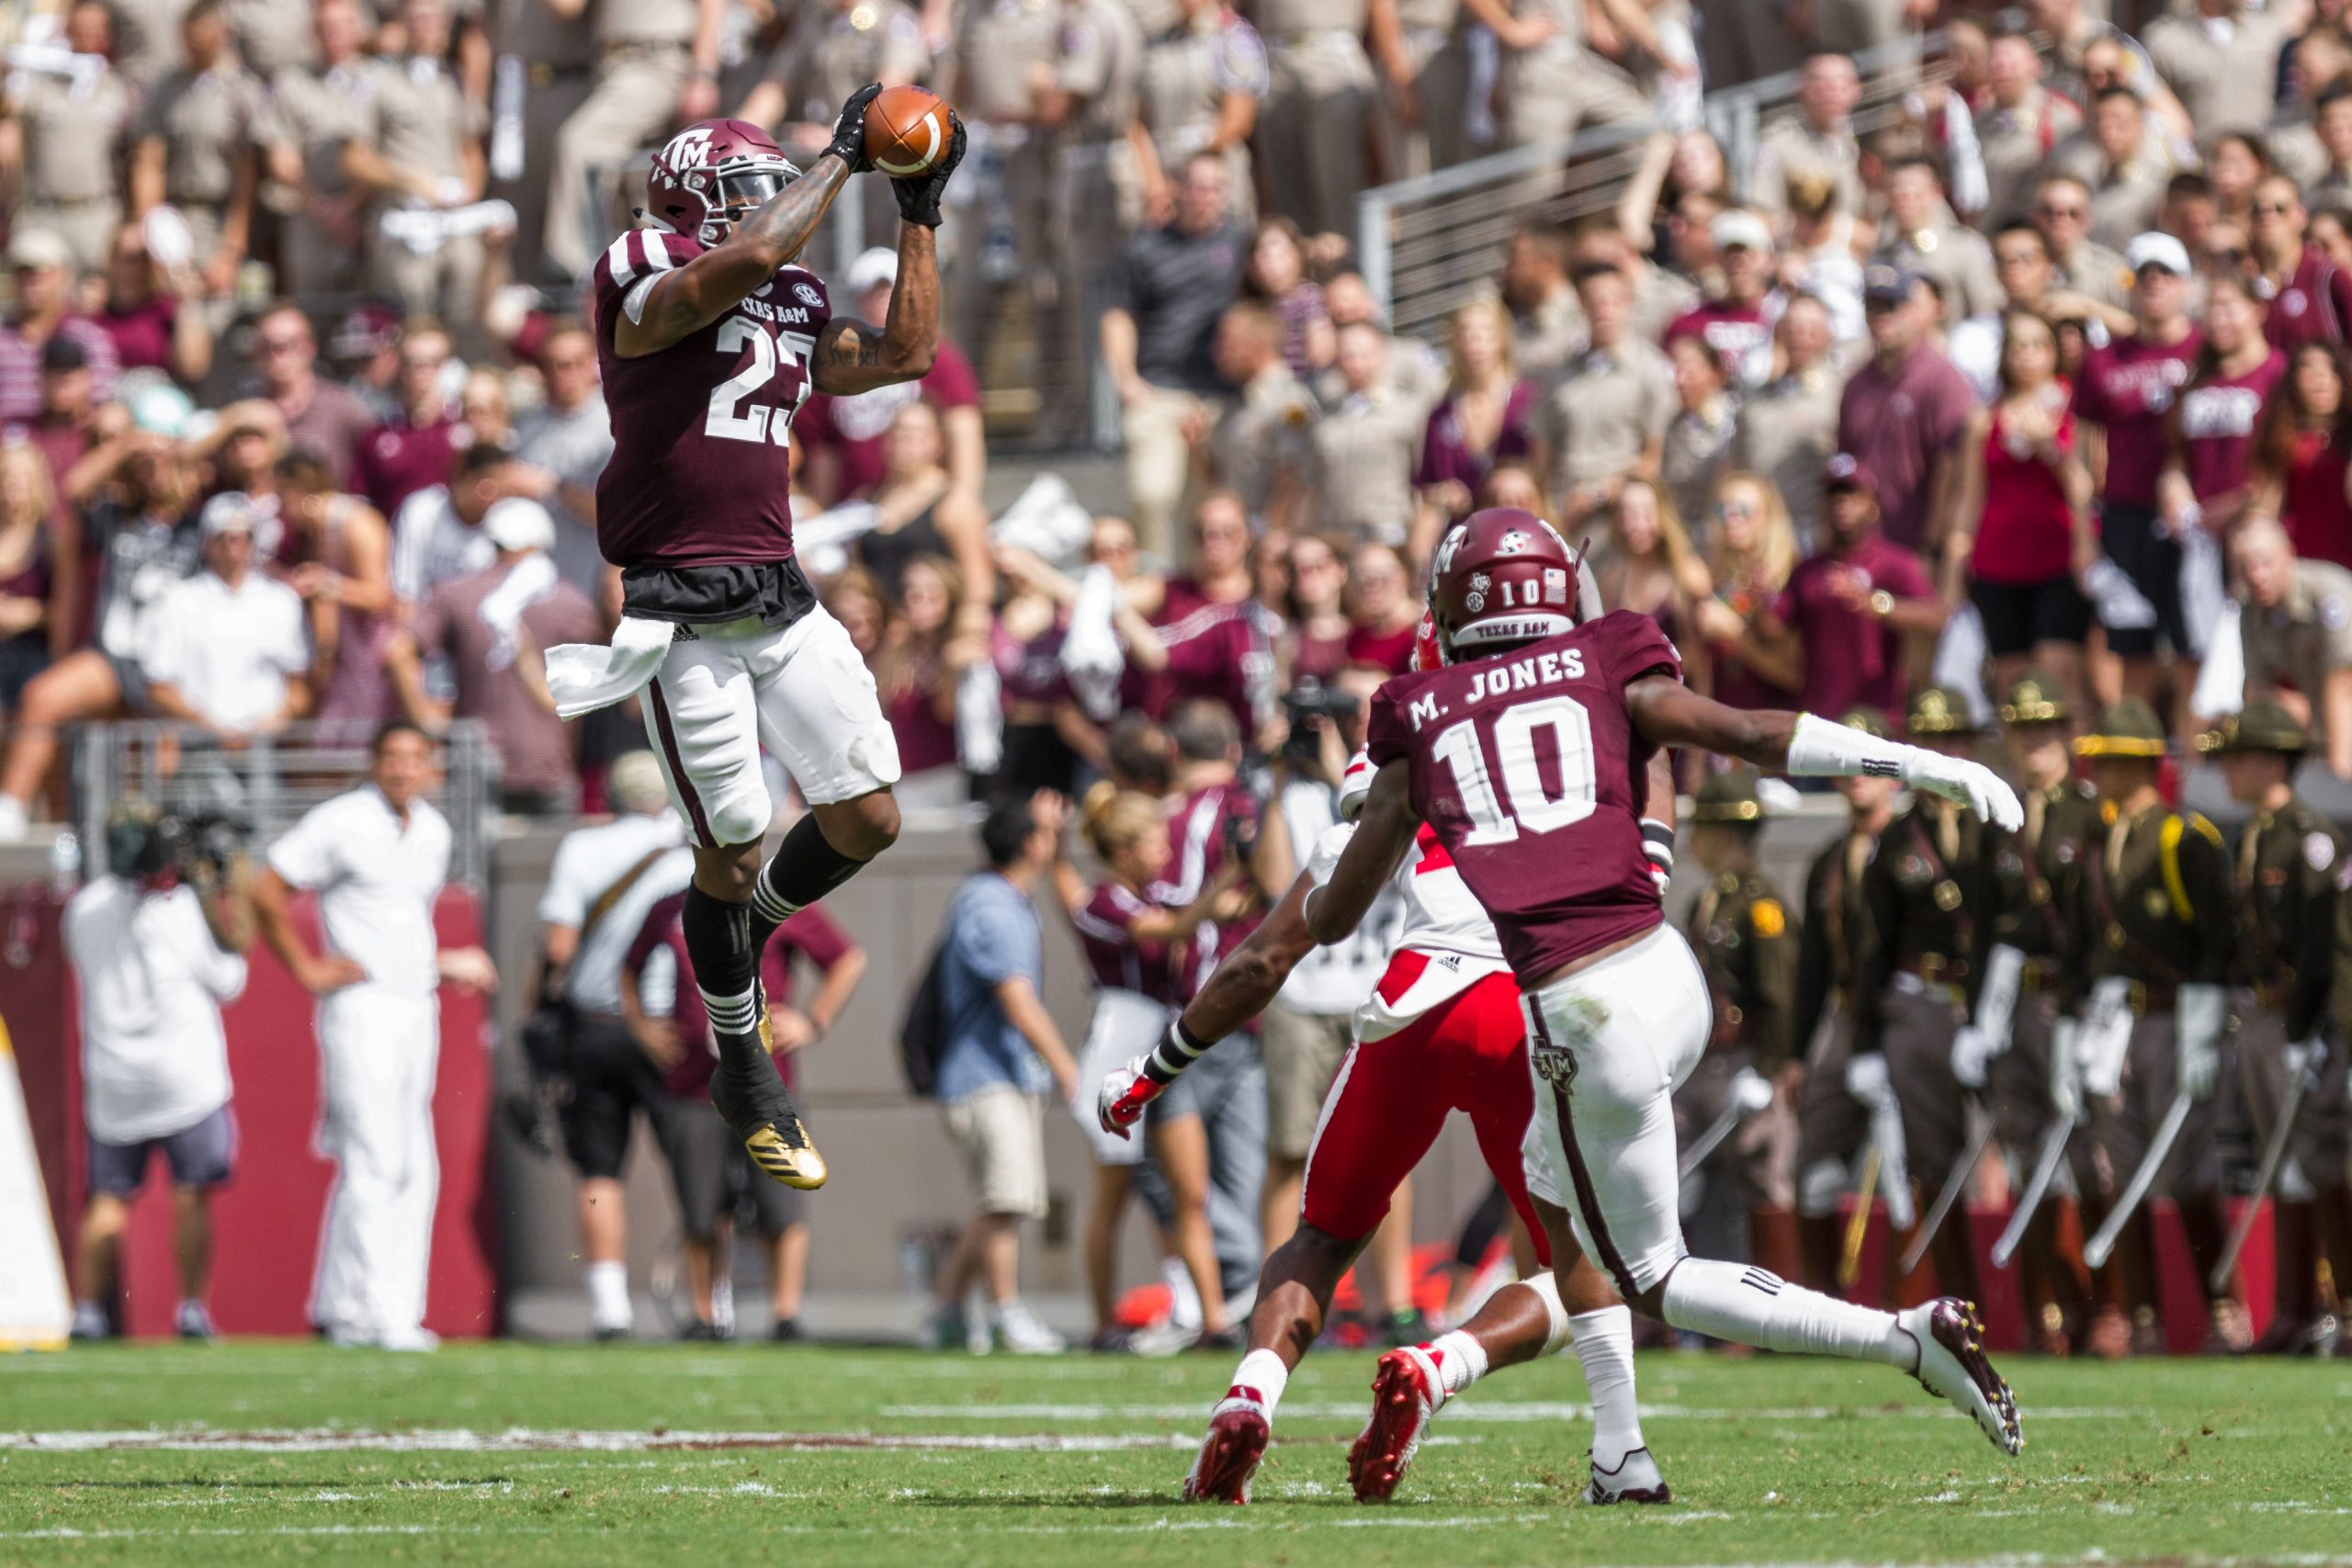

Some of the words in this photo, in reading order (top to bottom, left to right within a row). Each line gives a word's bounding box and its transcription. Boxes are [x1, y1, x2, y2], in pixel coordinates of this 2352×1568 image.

[794, 284, 823, 307] SEC
[776, 306, 809, 323] A&M
[705, 315, 817, 448] 23
[1501, 579, 1540, 606] 10
[1476, 623, 1519, 638] TEXAS
[1409, 692, 1449, 733] M.
[1465, 648, 1586, 705] JONES
[1431, 695, 1597, 847] 10
